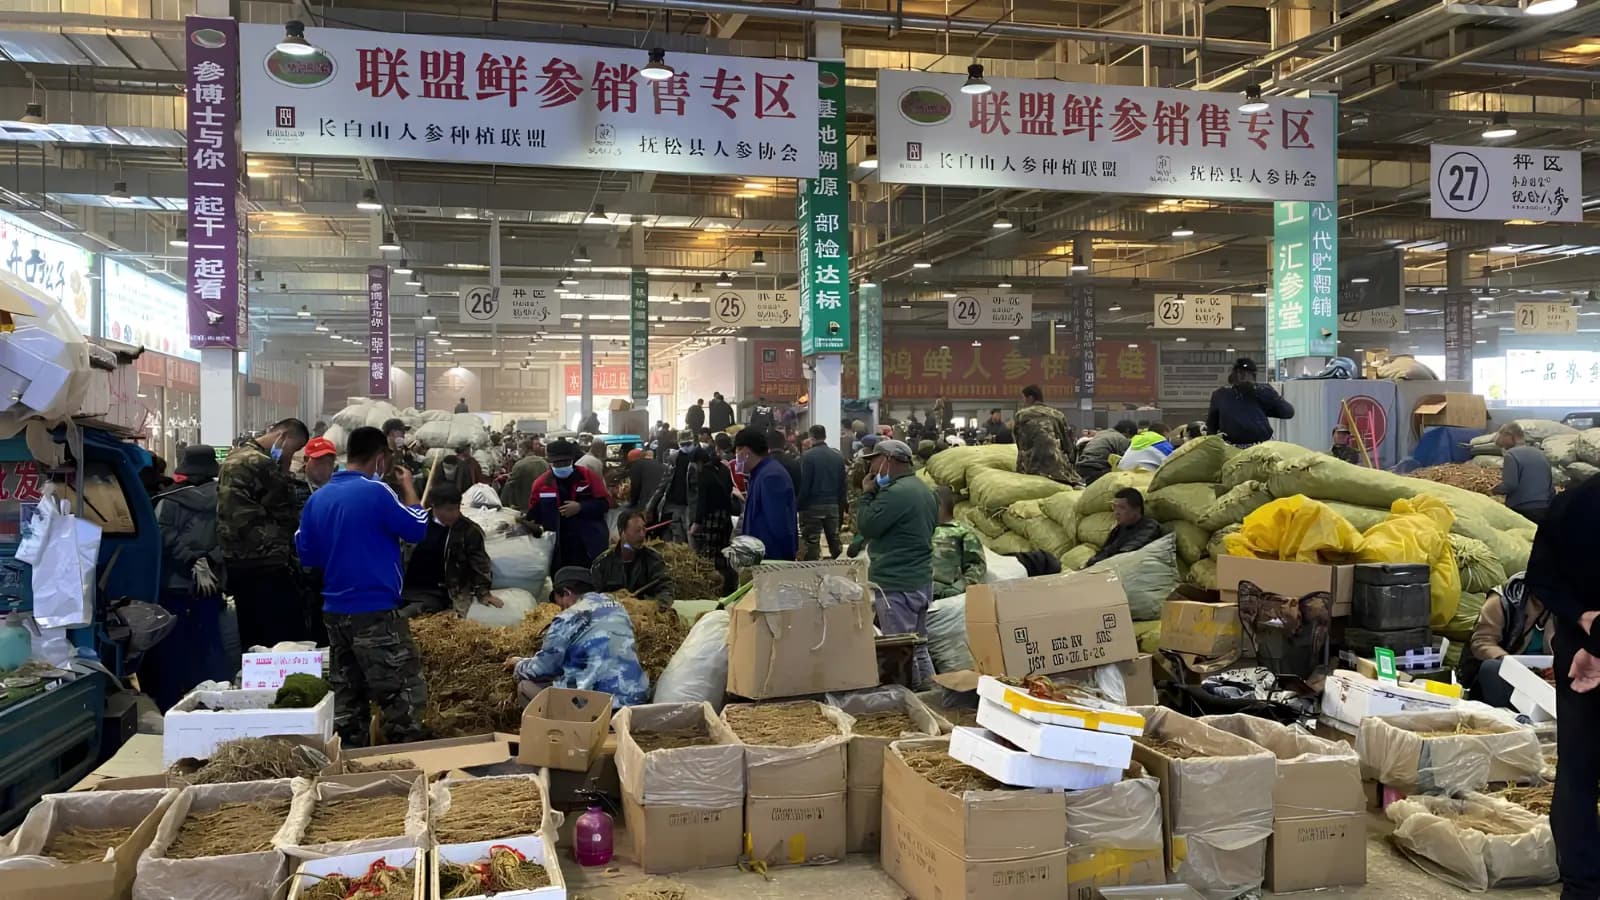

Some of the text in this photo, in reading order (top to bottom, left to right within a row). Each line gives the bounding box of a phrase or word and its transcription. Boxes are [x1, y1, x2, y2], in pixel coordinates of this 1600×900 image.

[355, 46, 797, 119] 联盟鲜参销售专区
[319, 117, 548, 149] 长白山人参种植联盟
[968, 90, 1315, 150] 联盟鲜参销售专区
[639, 135, 799, 162] 抚松县人参协会
[939, 152, 1117, 178] 长白山人参种植联盟
[1189, 164, 1317, 188] 抚松县人参协会
[1449, 165, 1479, 201] 27
[814, 213, 842, 310] 部检达标
[1278, 242, 1304, 331] 汇参堂
[471, 292, 493, 314] 26
[720, 297, 740, 317] 25
[958, 301, 977, 320] 24
[1163, 302, 1180, 320] 23
[1522, 309, 1534, 326] 21
